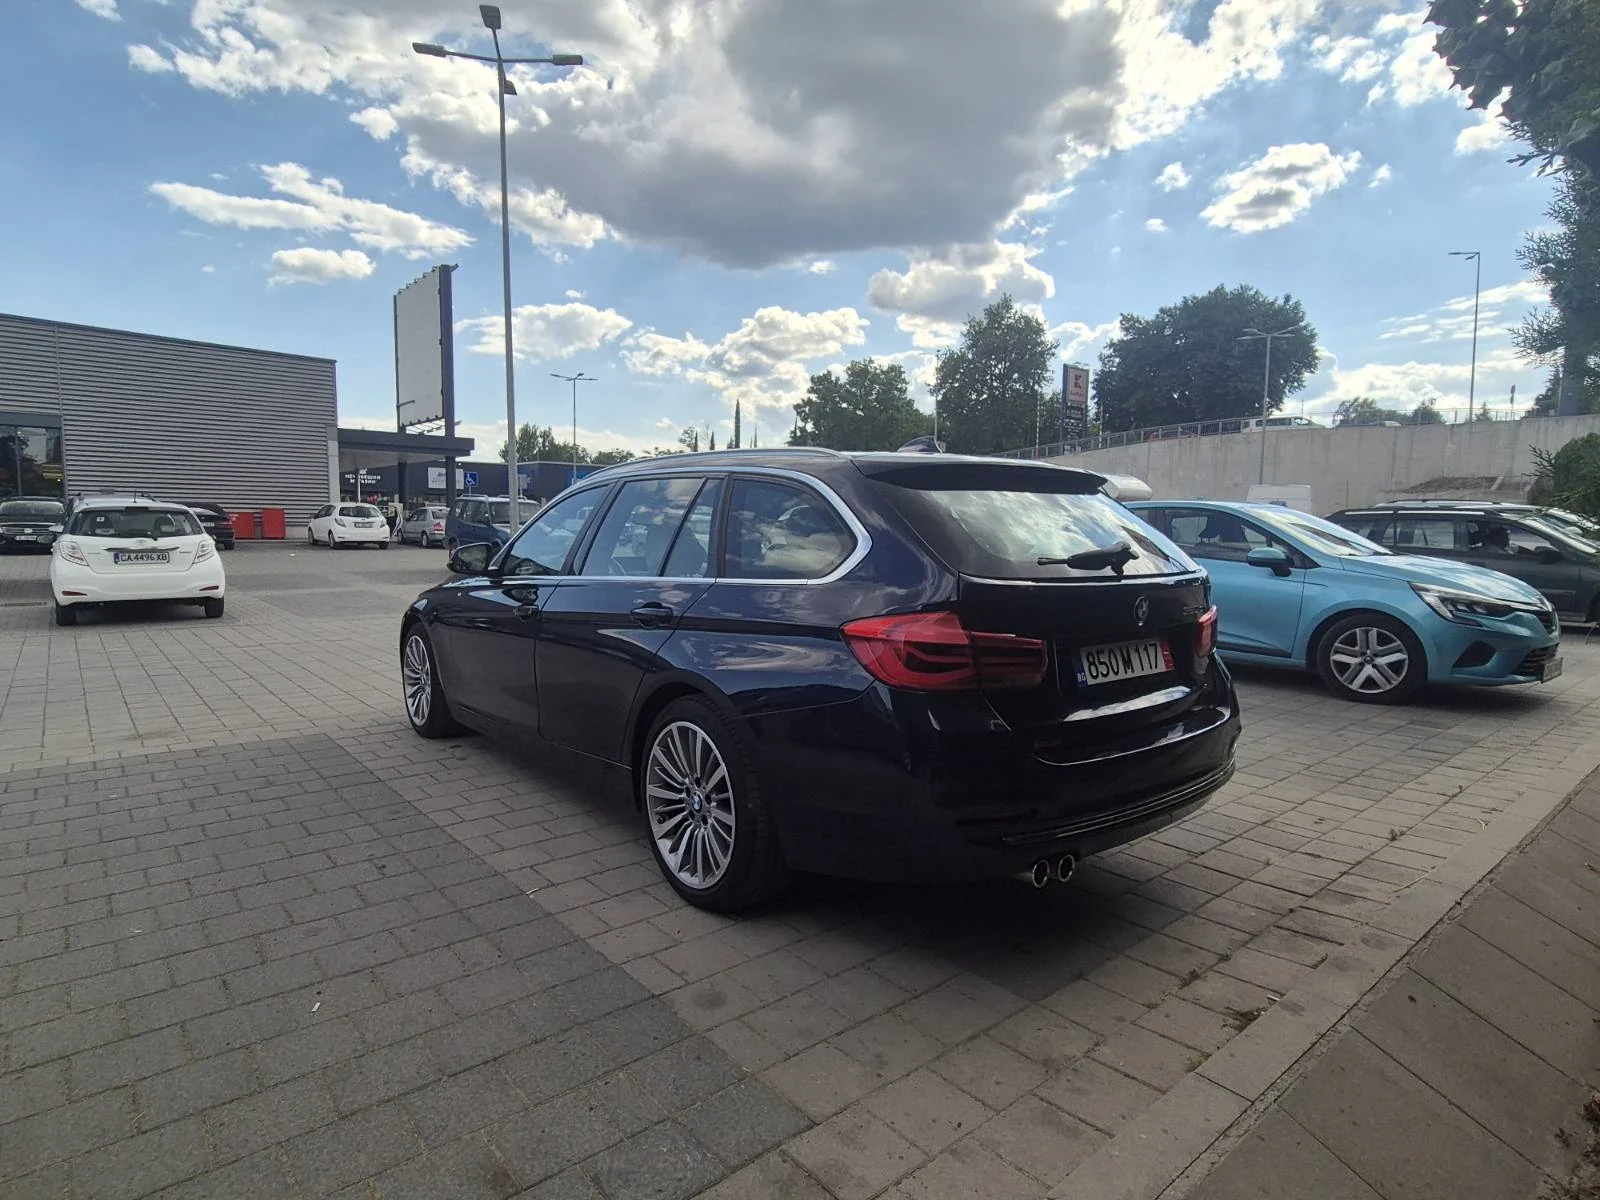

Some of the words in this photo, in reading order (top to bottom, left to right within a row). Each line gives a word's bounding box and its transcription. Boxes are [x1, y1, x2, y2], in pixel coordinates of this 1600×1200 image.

[120, 554, 133, 562] CA
[133, 554, 155, 562] 4496
[156, 553, 167, 561] XB
